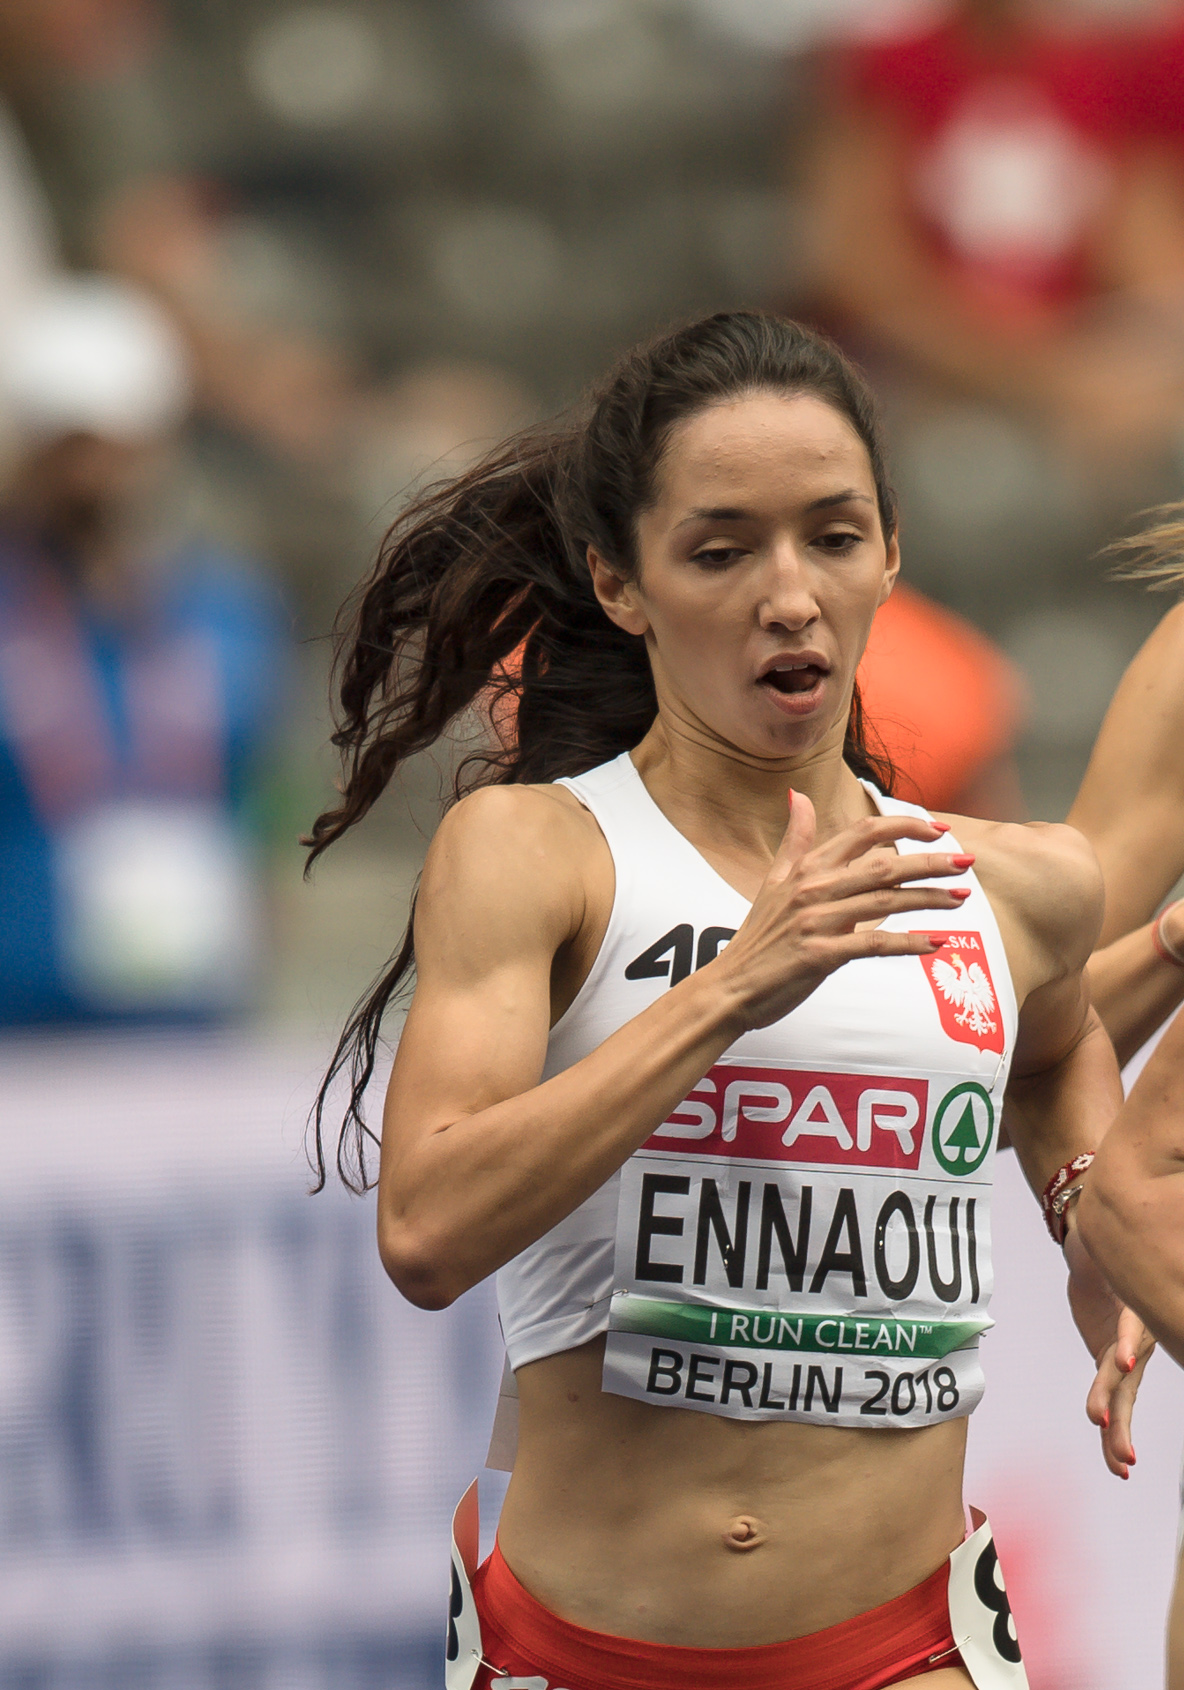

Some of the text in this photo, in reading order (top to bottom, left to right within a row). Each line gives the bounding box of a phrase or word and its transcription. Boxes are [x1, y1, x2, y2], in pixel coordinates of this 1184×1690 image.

[652, 1077, 920, 1155] SPAR
[635, 1173, 980, 1304] ENNAOUI
[709, 1312, 718, 1338] I
[730, 1314, 804, 1346] RUN
[646, 1347, 960, 1417] BERLIN 2018
